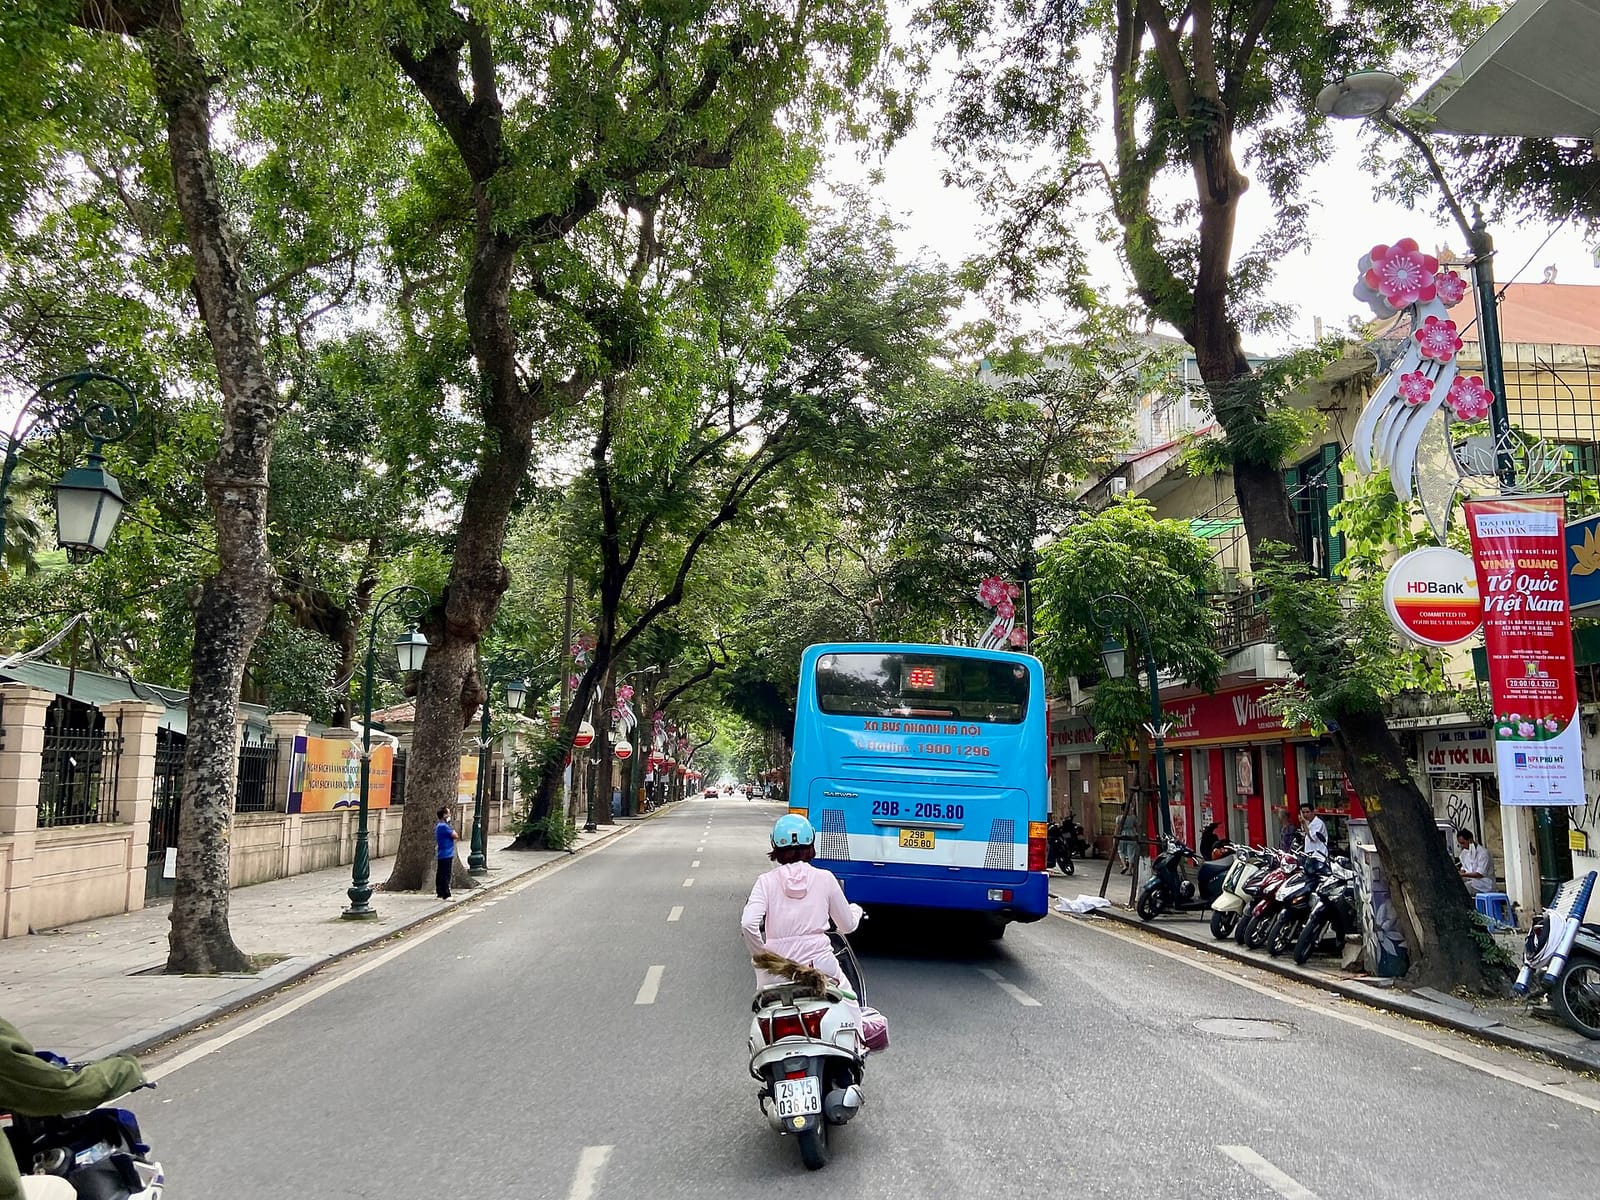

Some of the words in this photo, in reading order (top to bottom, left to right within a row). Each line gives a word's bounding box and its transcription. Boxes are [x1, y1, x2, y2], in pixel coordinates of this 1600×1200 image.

[1480, 559, 1515, 570] VINH
[1517, 558, 1559, 570] QUANG
[1407, 581, 1464, 594] HDBank
[1487, 569, 1514, 592] Tổ
[1516, 570, 1559, 595] Quốc
[1484, 594, 1522, 616] Việt
[1525, 595, 1564, 612] Nam
[881, 721, 900, 732] BUS
[903, 722, 940, 734] NHANH
[918, 742, 952, 755] 1900
[956, 745, 990, 757] 1296
[872, 800, 899, 816] 29B
[914, 802, 964, 819] 205.80
[909, 831, 925, 839] 29B
